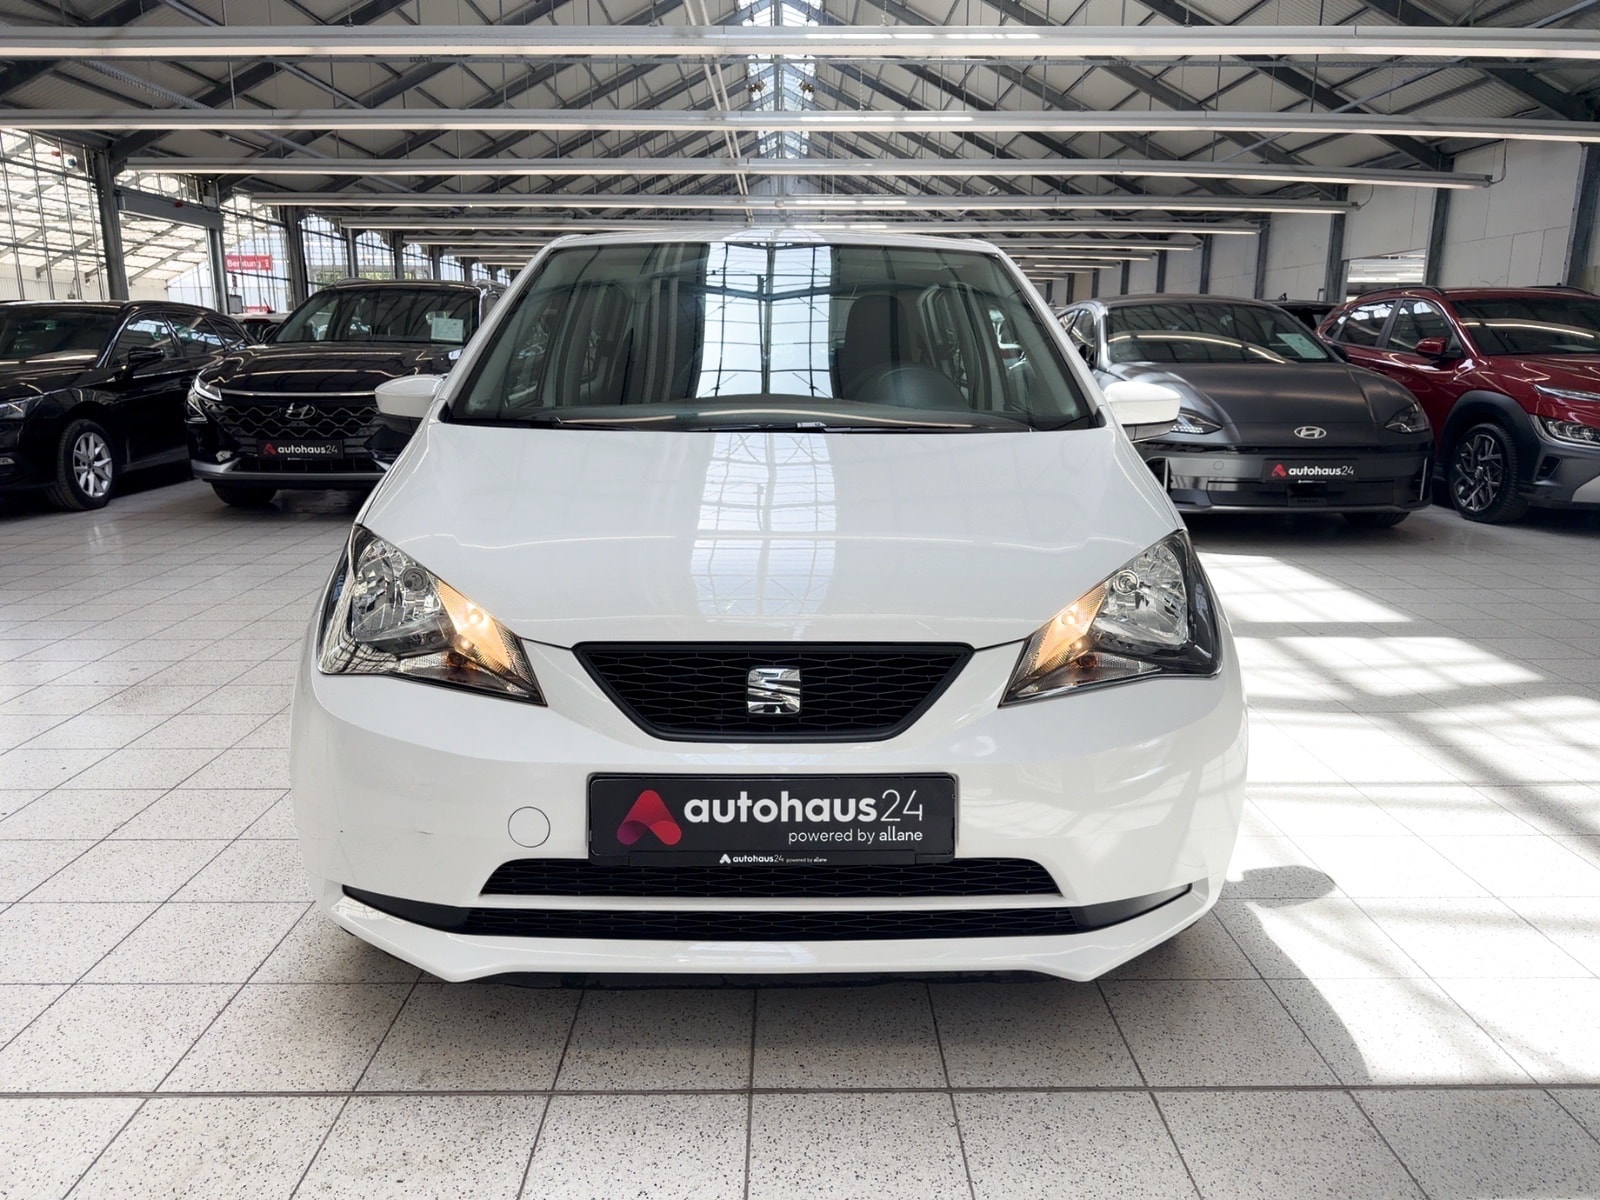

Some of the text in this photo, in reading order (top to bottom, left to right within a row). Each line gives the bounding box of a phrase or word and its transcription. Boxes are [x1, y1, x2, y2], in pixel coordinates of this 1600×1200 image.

[277, 444, 338, 454] autohaus24
[1288, 465, 1354, 476] autohaus24
[684, 789, 923, 823] autohaus24
[788, 826, 923, 845] powered by allane
[732, 854, 785, 863] autohaus24
